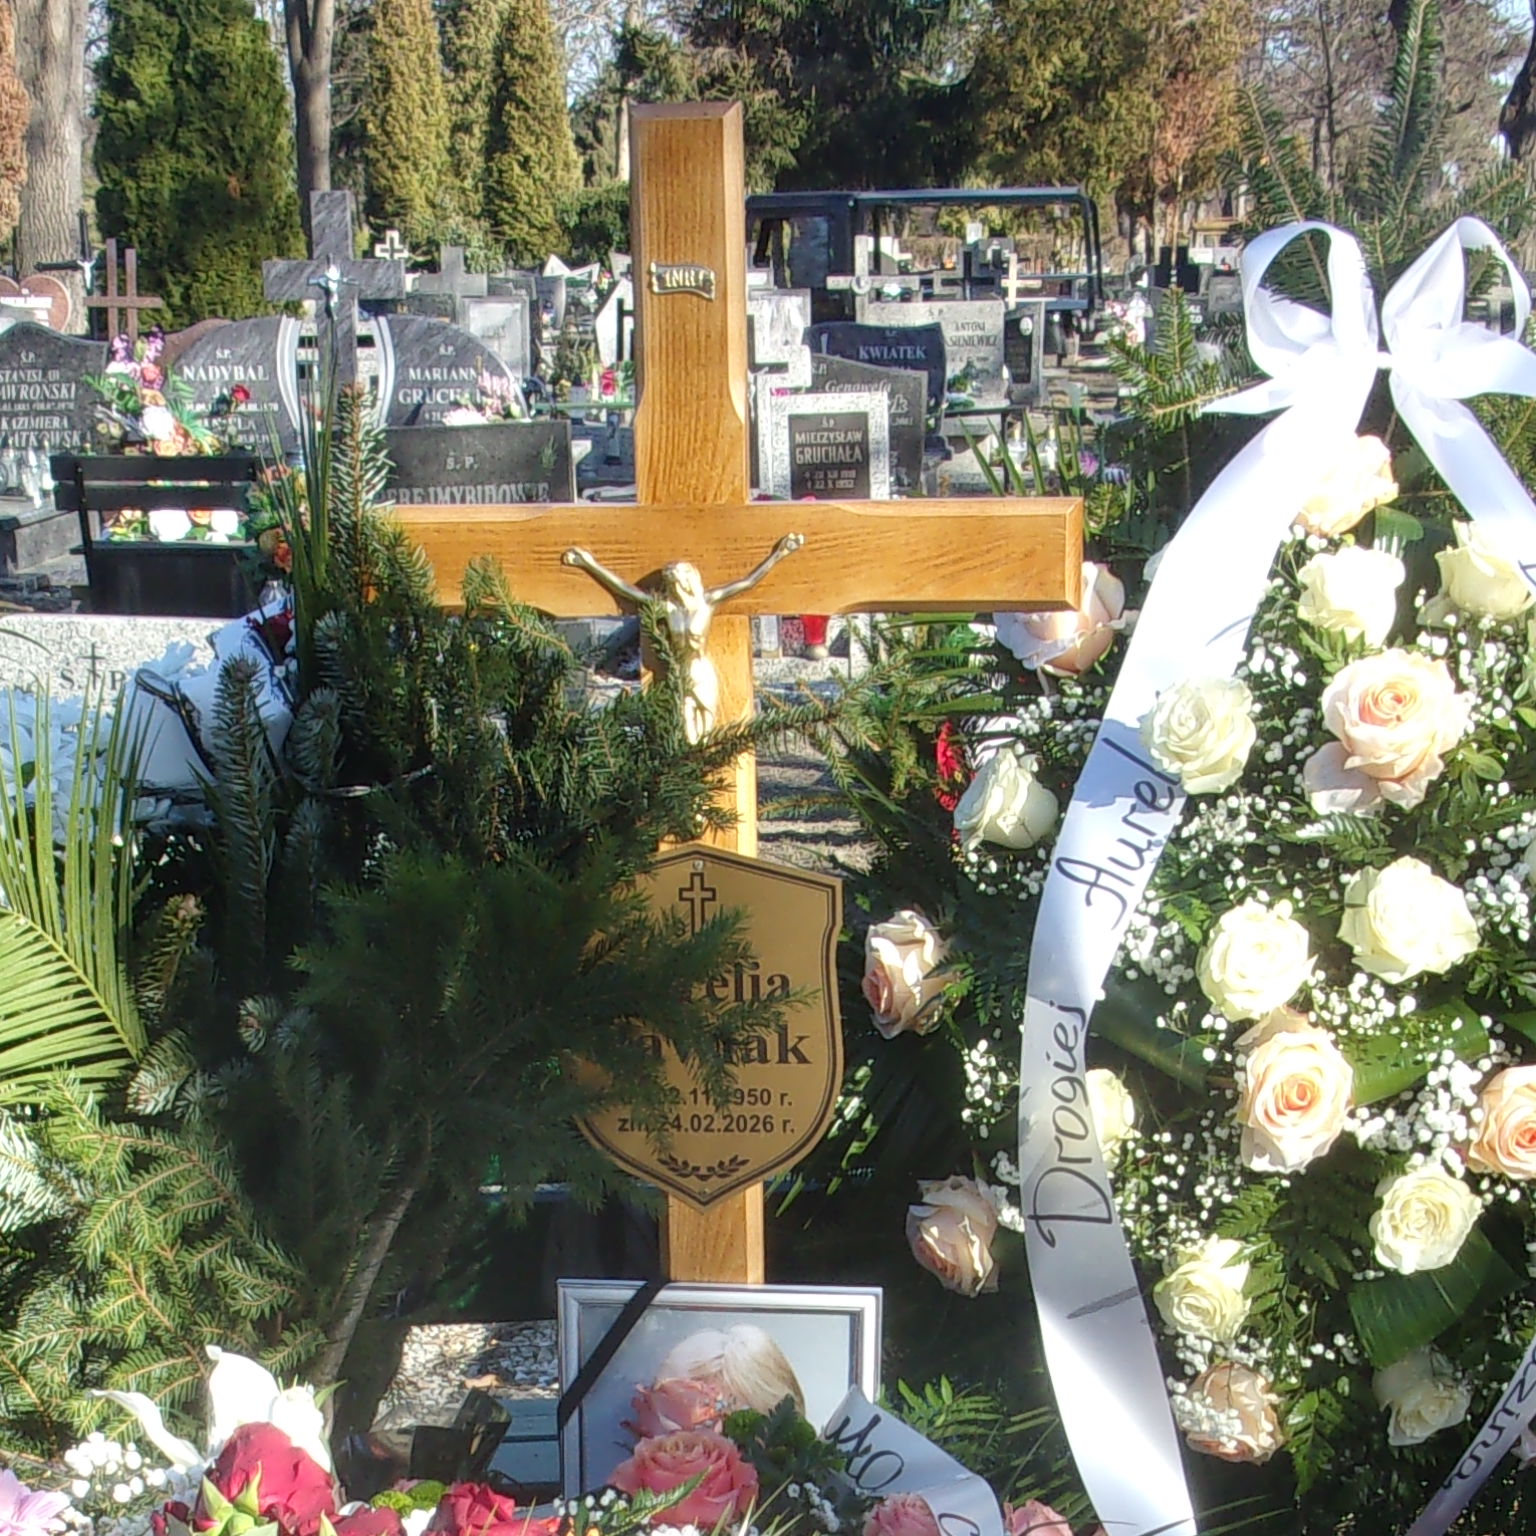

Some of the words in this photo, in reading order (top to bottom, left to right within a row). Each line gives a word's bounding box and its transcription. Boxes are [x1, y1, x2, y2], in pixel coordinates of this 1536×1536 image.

[859, 345, 927, 360] KWIATEK
[408, 367, 480, 382] MARIANN
[795, 444, 864, 465] GRUCHAŁA
[1054, 735, 1184, 931] Aurel
[1026, 1000, 1114, 1249] Drogiej
